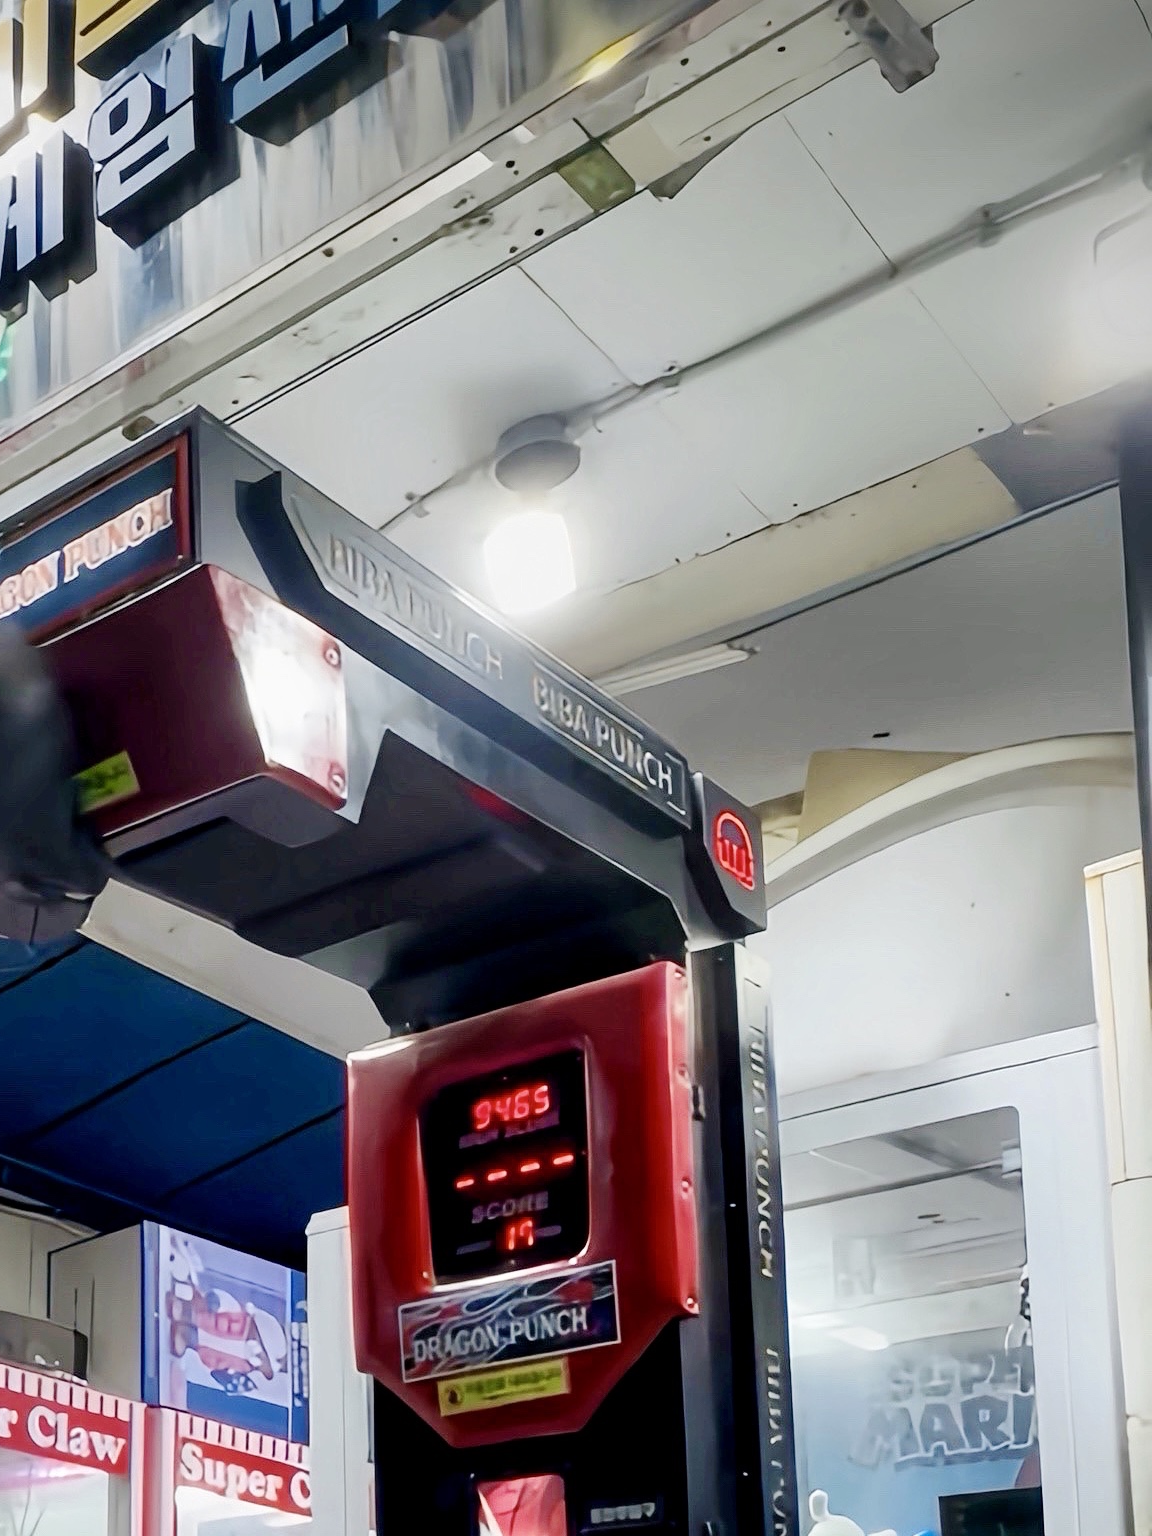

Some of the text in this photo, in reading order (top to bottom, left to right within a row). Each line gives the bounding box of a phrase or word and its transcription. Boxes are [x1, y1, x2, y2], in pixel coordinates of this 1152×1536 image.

[62, 488, 173, 583] PUNCH
[533, 673, 673, 796] BIBA PUNCH
[475, 1084, 550, 1130] 9465
[412, 1306, 588, 1363] DRAGON PUNCH
[27, 1404, 127, 1466] Claw
[850, 1395, 1035, 1465] MARI
[180, 1443, 284, 1500] Super
